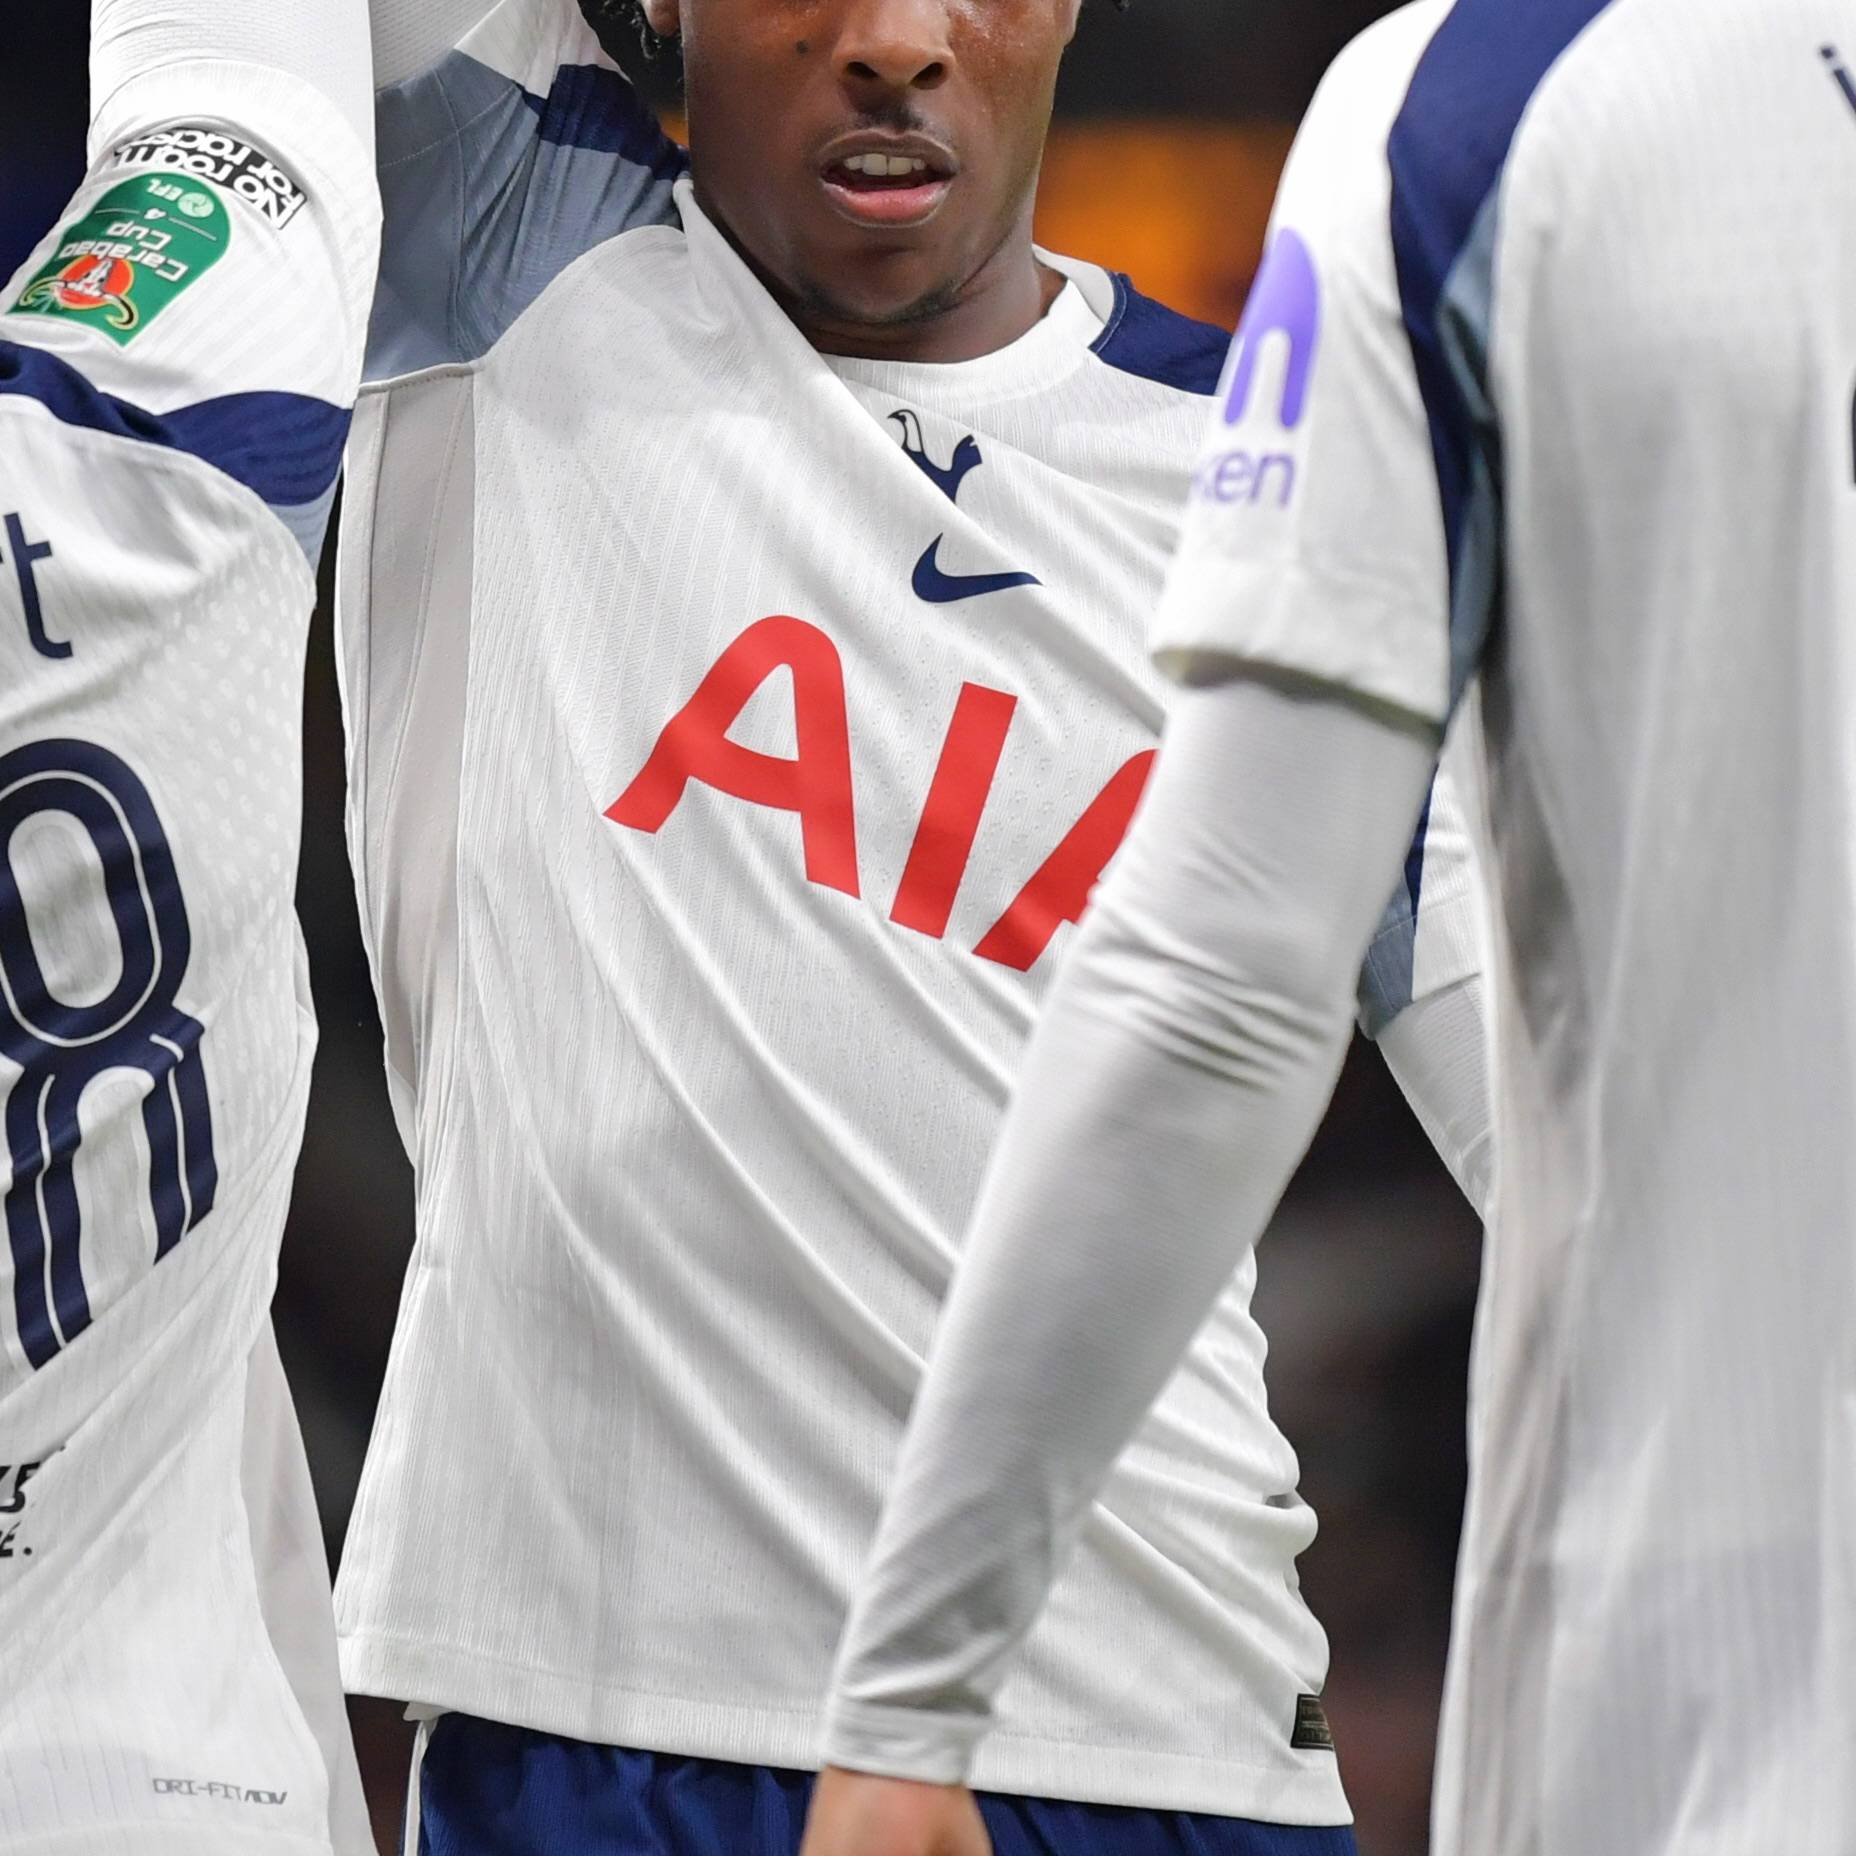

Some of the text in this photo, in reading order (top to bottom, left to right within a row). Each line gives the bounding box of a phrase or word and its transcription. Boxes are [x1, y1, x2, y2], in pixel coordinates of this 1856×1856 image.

[117, 145, 294, 229] No room
[146, 178, 183, 201] EFL
[106, 221, 172, 251] Cup
[58, 241, 188, 282] Carabao
